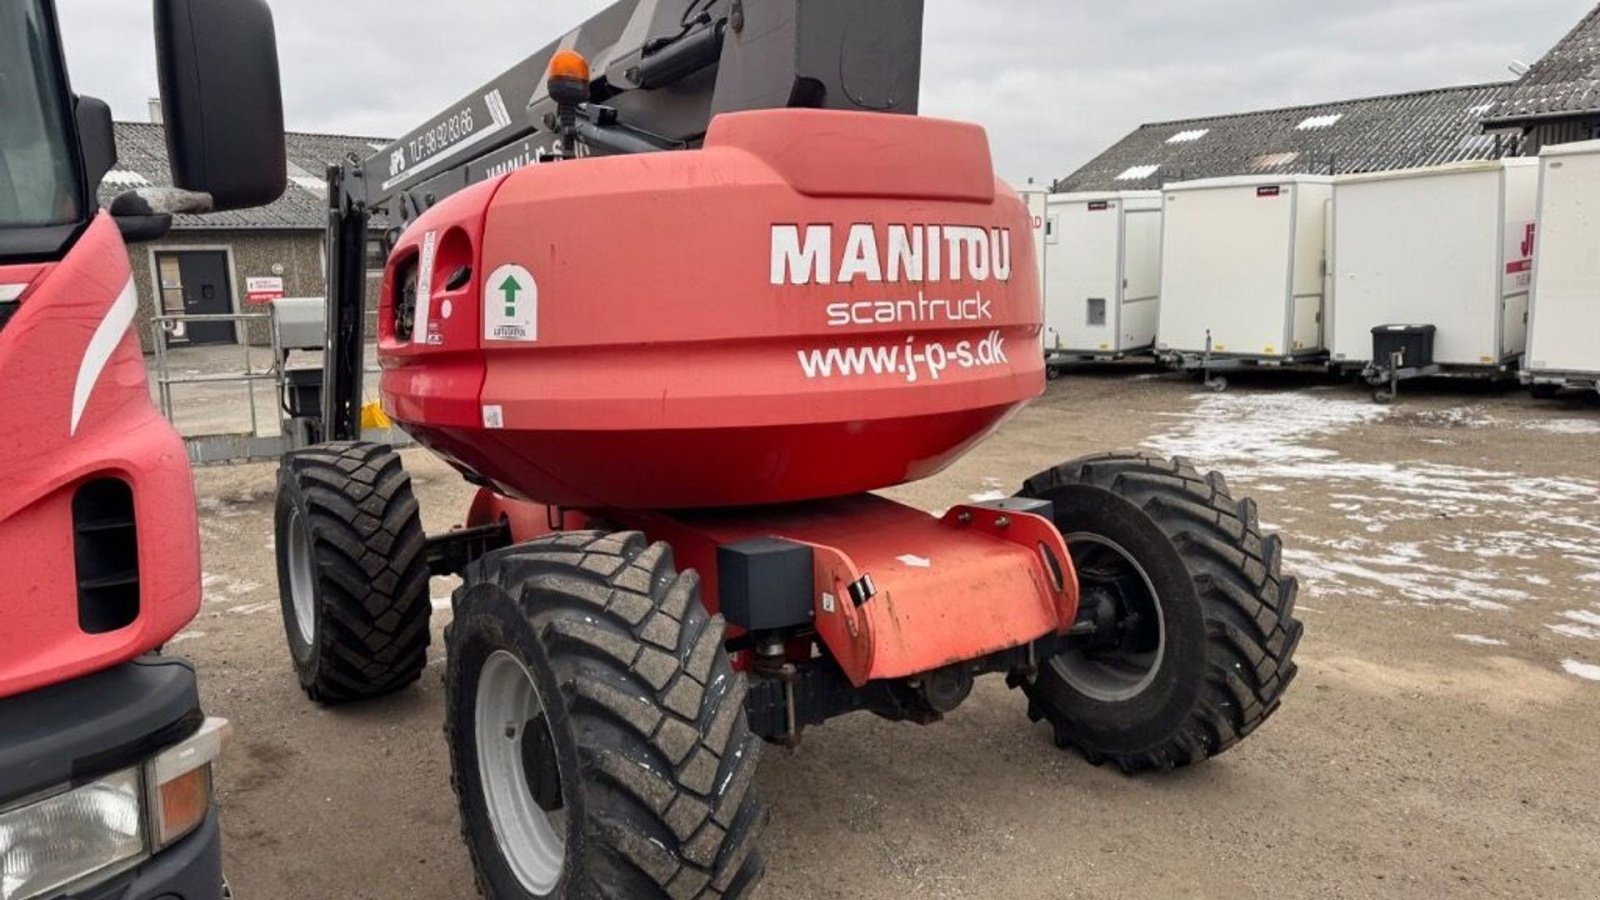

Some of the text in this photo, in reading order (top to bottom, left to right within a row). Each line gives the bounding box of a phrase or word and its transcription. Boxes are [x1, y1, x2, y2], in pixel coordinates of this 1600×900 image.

[436, 121, 449, 149] 92
[448, 114, 460, 142] 83
[769, 224, 1012, 285] MANITOU
[826, 291, 992, 325] scantruck
[797, 330, 1008, 382] www.j-p-s.dk
